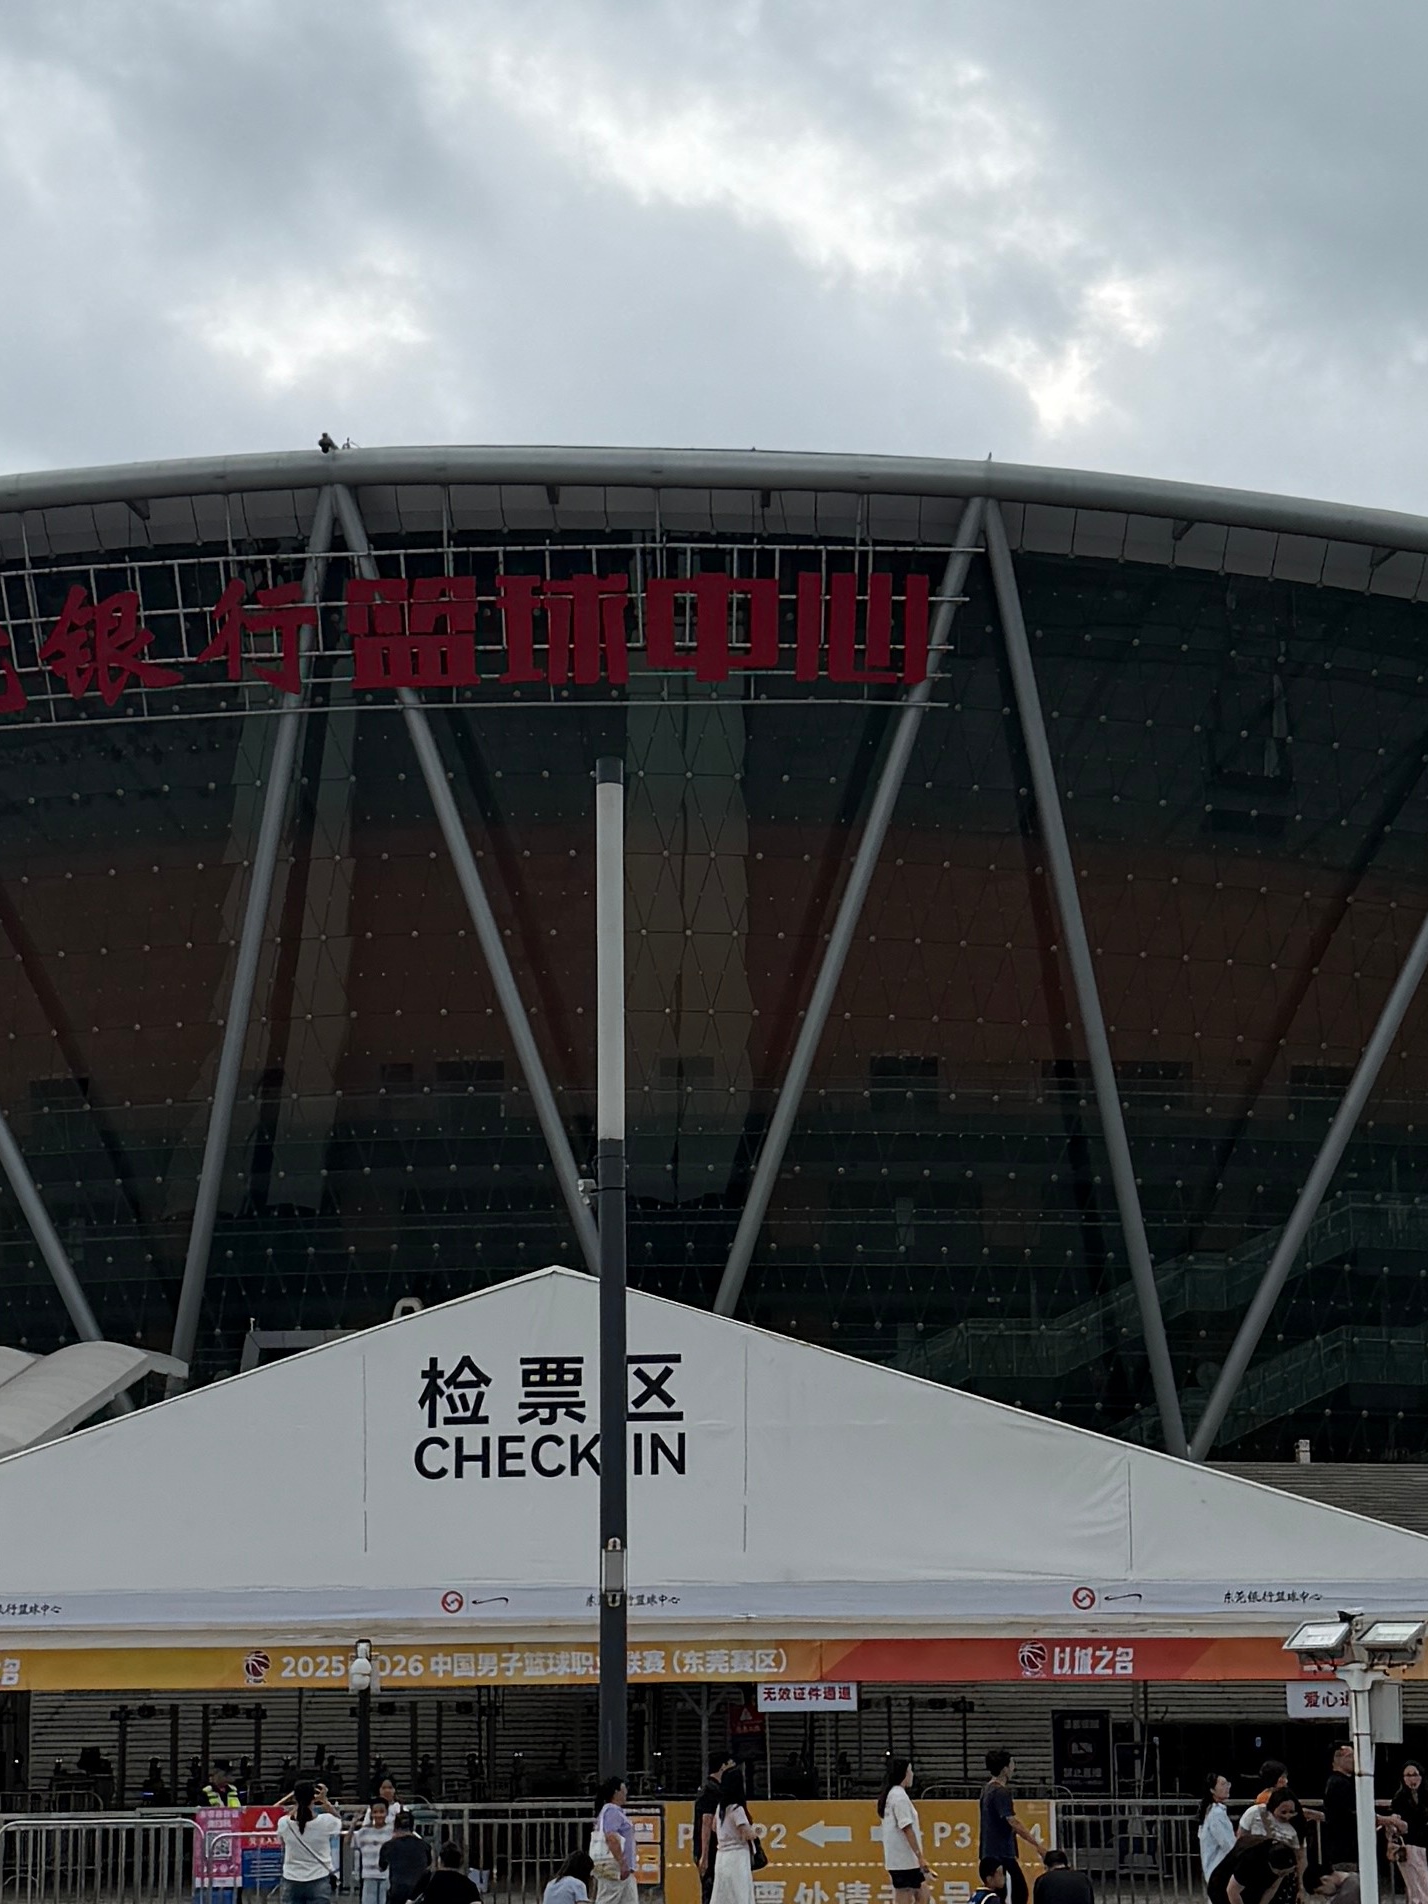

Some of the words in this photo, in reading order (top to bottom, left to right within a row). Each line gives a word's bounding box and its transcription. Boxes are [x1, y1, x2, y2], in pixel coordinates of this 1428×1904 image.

[418, 1354, 684, 1428] 检票区
[414, 1432, 686, 1480] CHECKIN
[933, 1822, 971, 1848] P3
